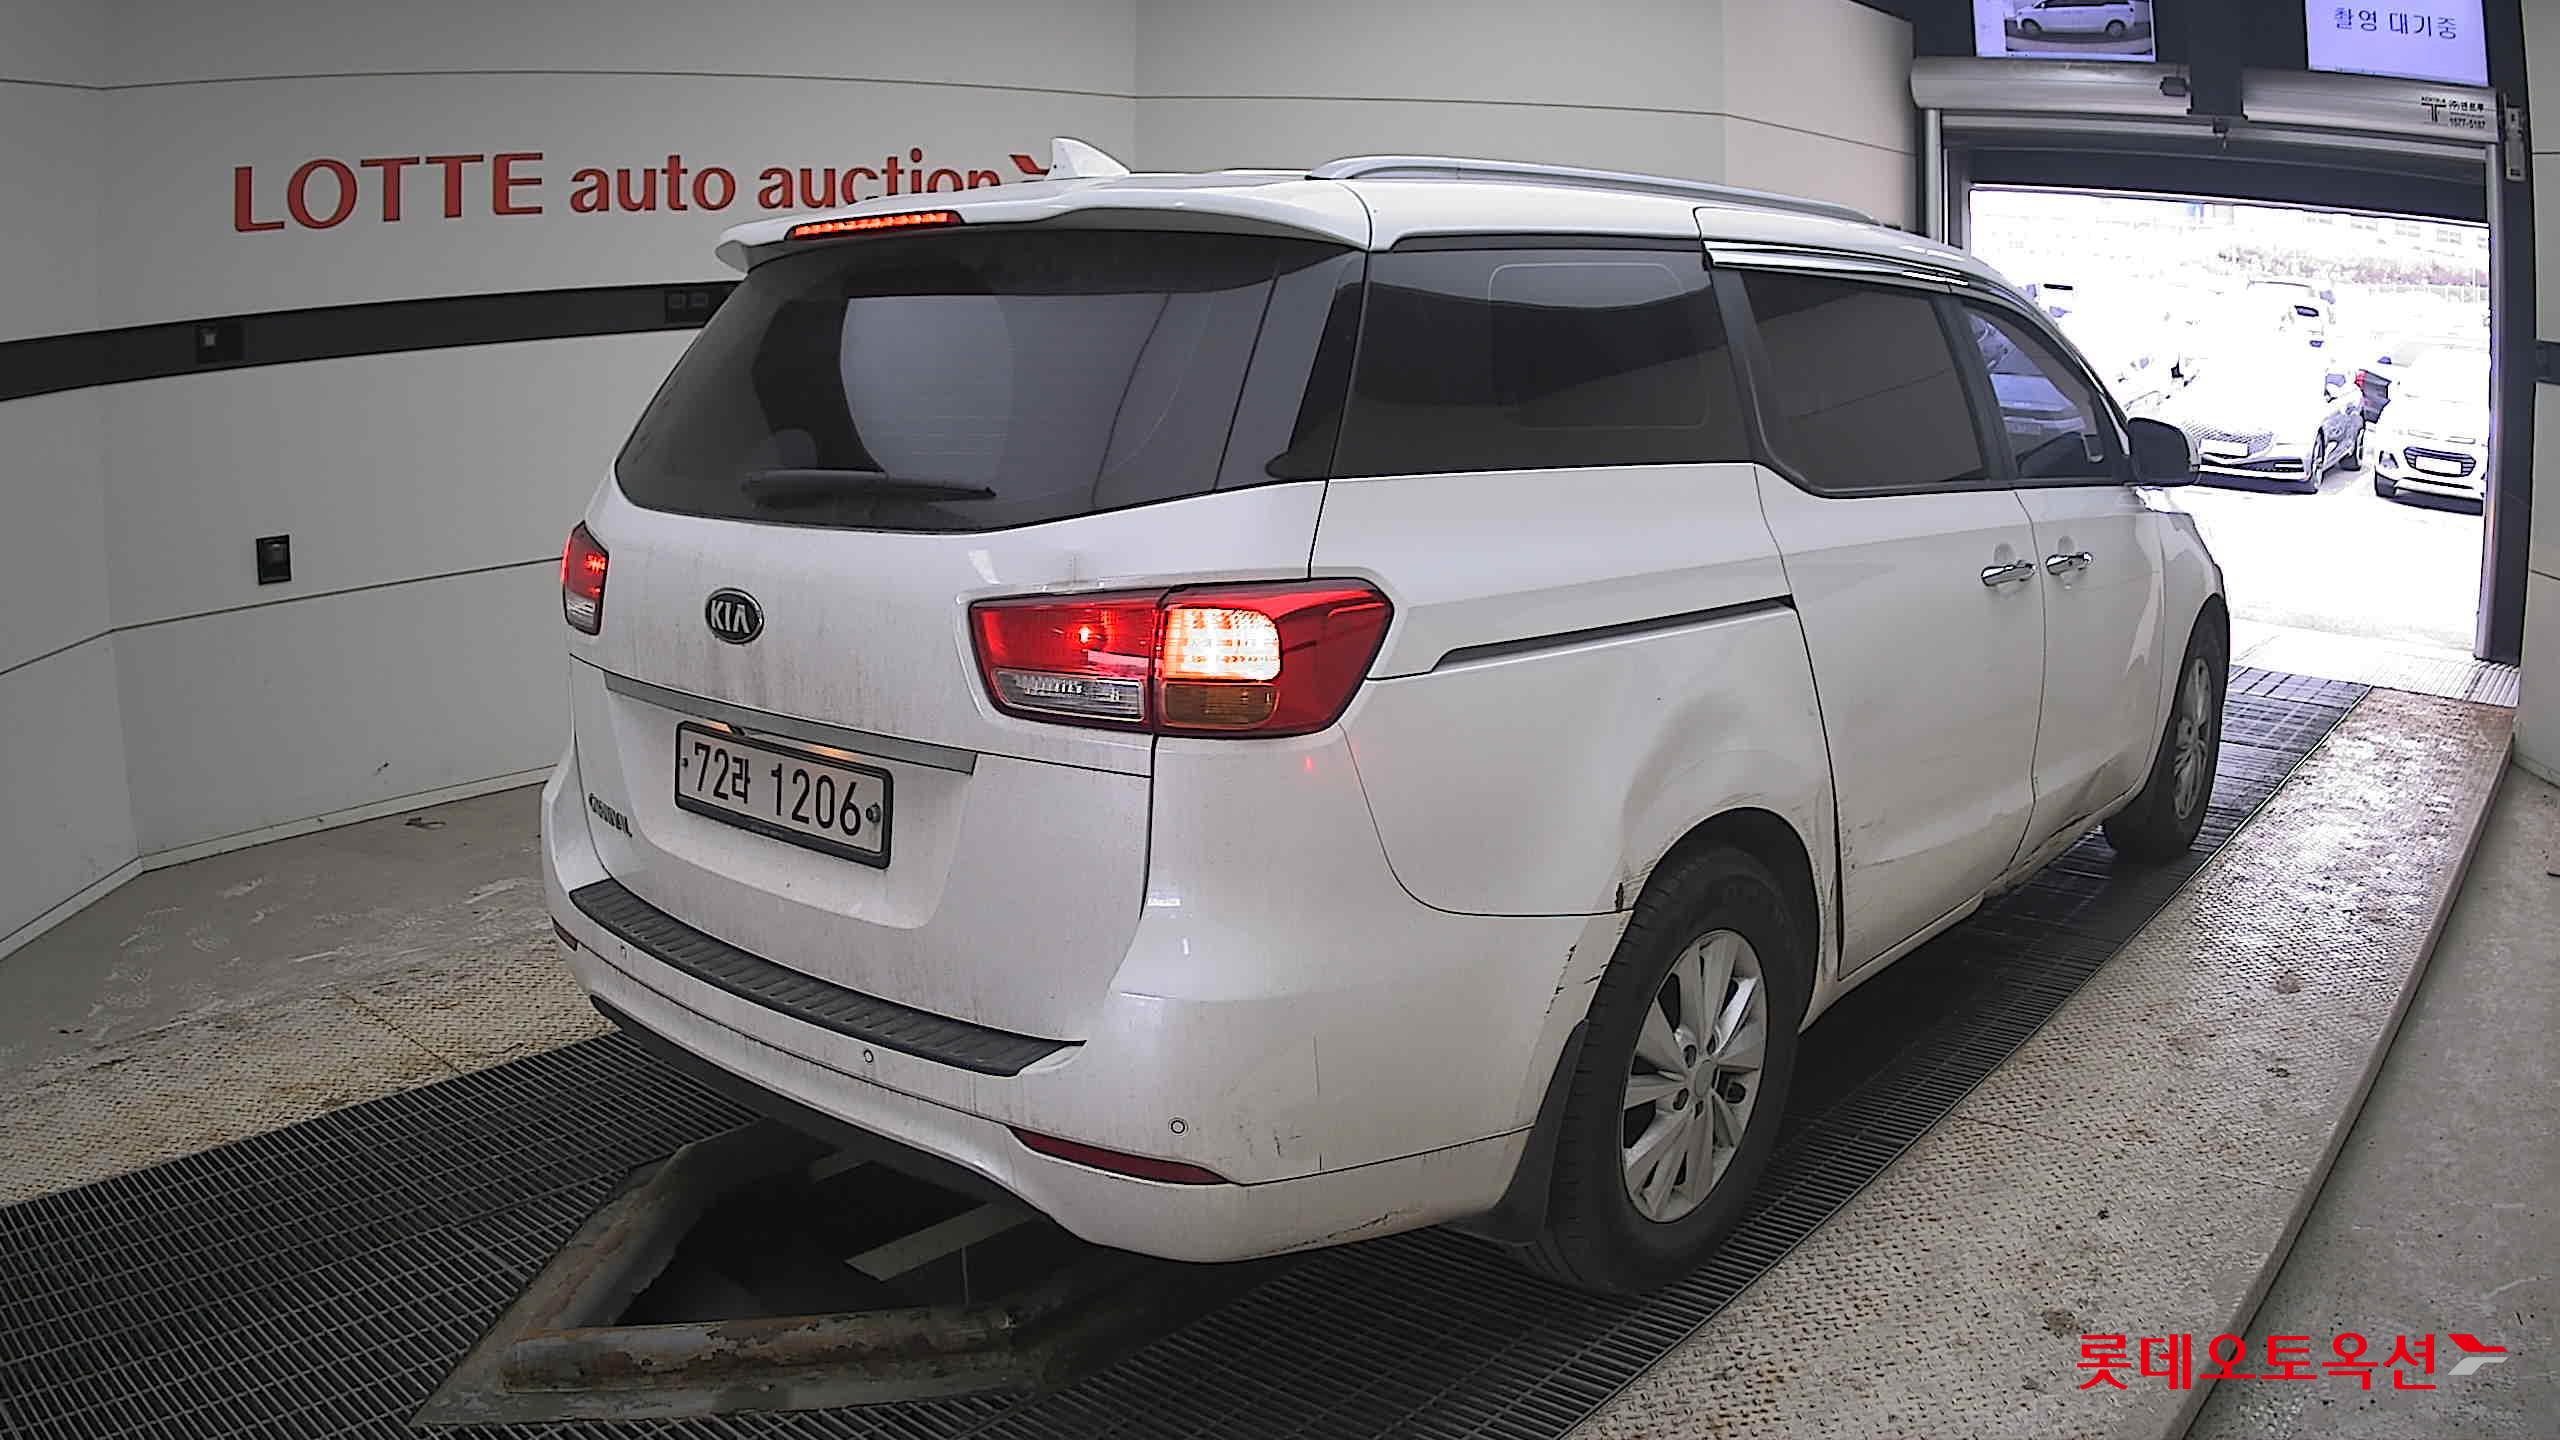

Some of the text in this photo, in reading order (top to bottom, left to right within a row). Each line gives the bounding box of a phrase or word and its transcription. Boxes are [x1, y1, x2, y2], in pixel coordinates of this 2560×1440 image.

[2334, 8, 2456, 40] 촬영 대기중
[234, 152, 544, 232] LOTTE
[569, 153, 736, 212] auto
[710, 600, 752, 634] KIA
[694, 742, 862, 836] 72라 1206
